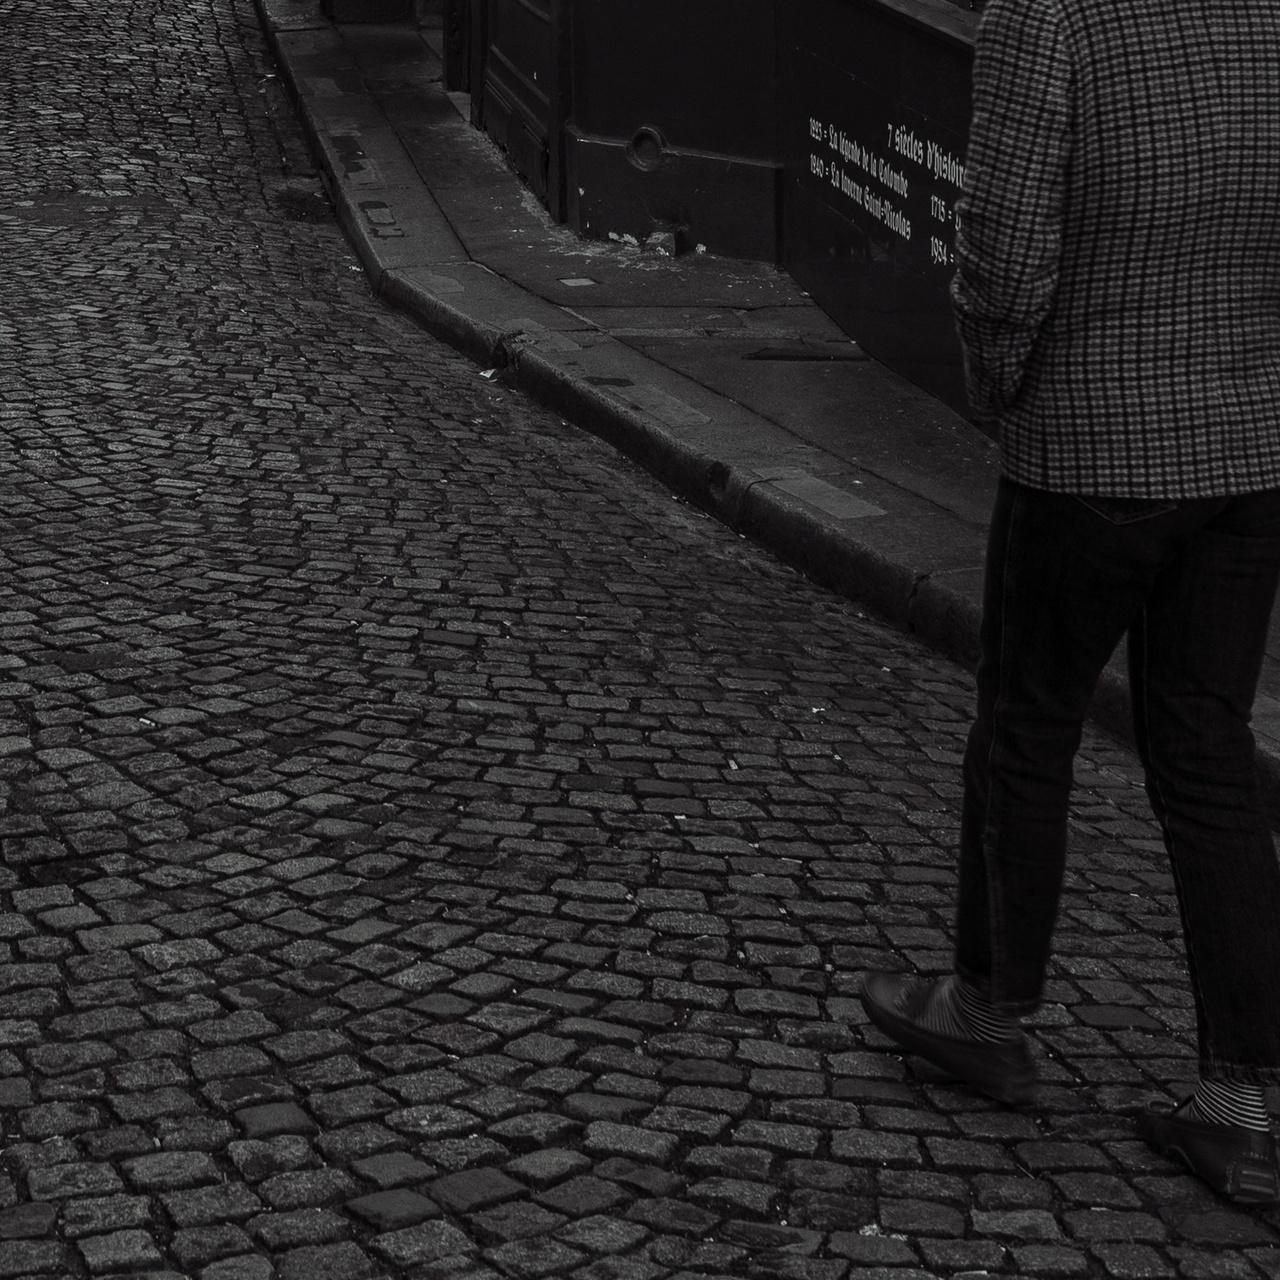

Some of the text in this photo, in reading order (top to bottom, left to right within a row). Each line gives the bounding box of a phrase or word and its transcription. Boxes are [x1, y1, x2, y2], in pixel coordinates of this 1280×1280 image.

[888, 123, 893, 148] 7
[895, 124, 924, 165] siècles
[862, 145, 869, 172] de
[870, 151, 877, 178] la
[878, 157, 909, 198] Colombe
[930, 194, 946, 223] 1715
[930, 235, 947, 266] 1954
